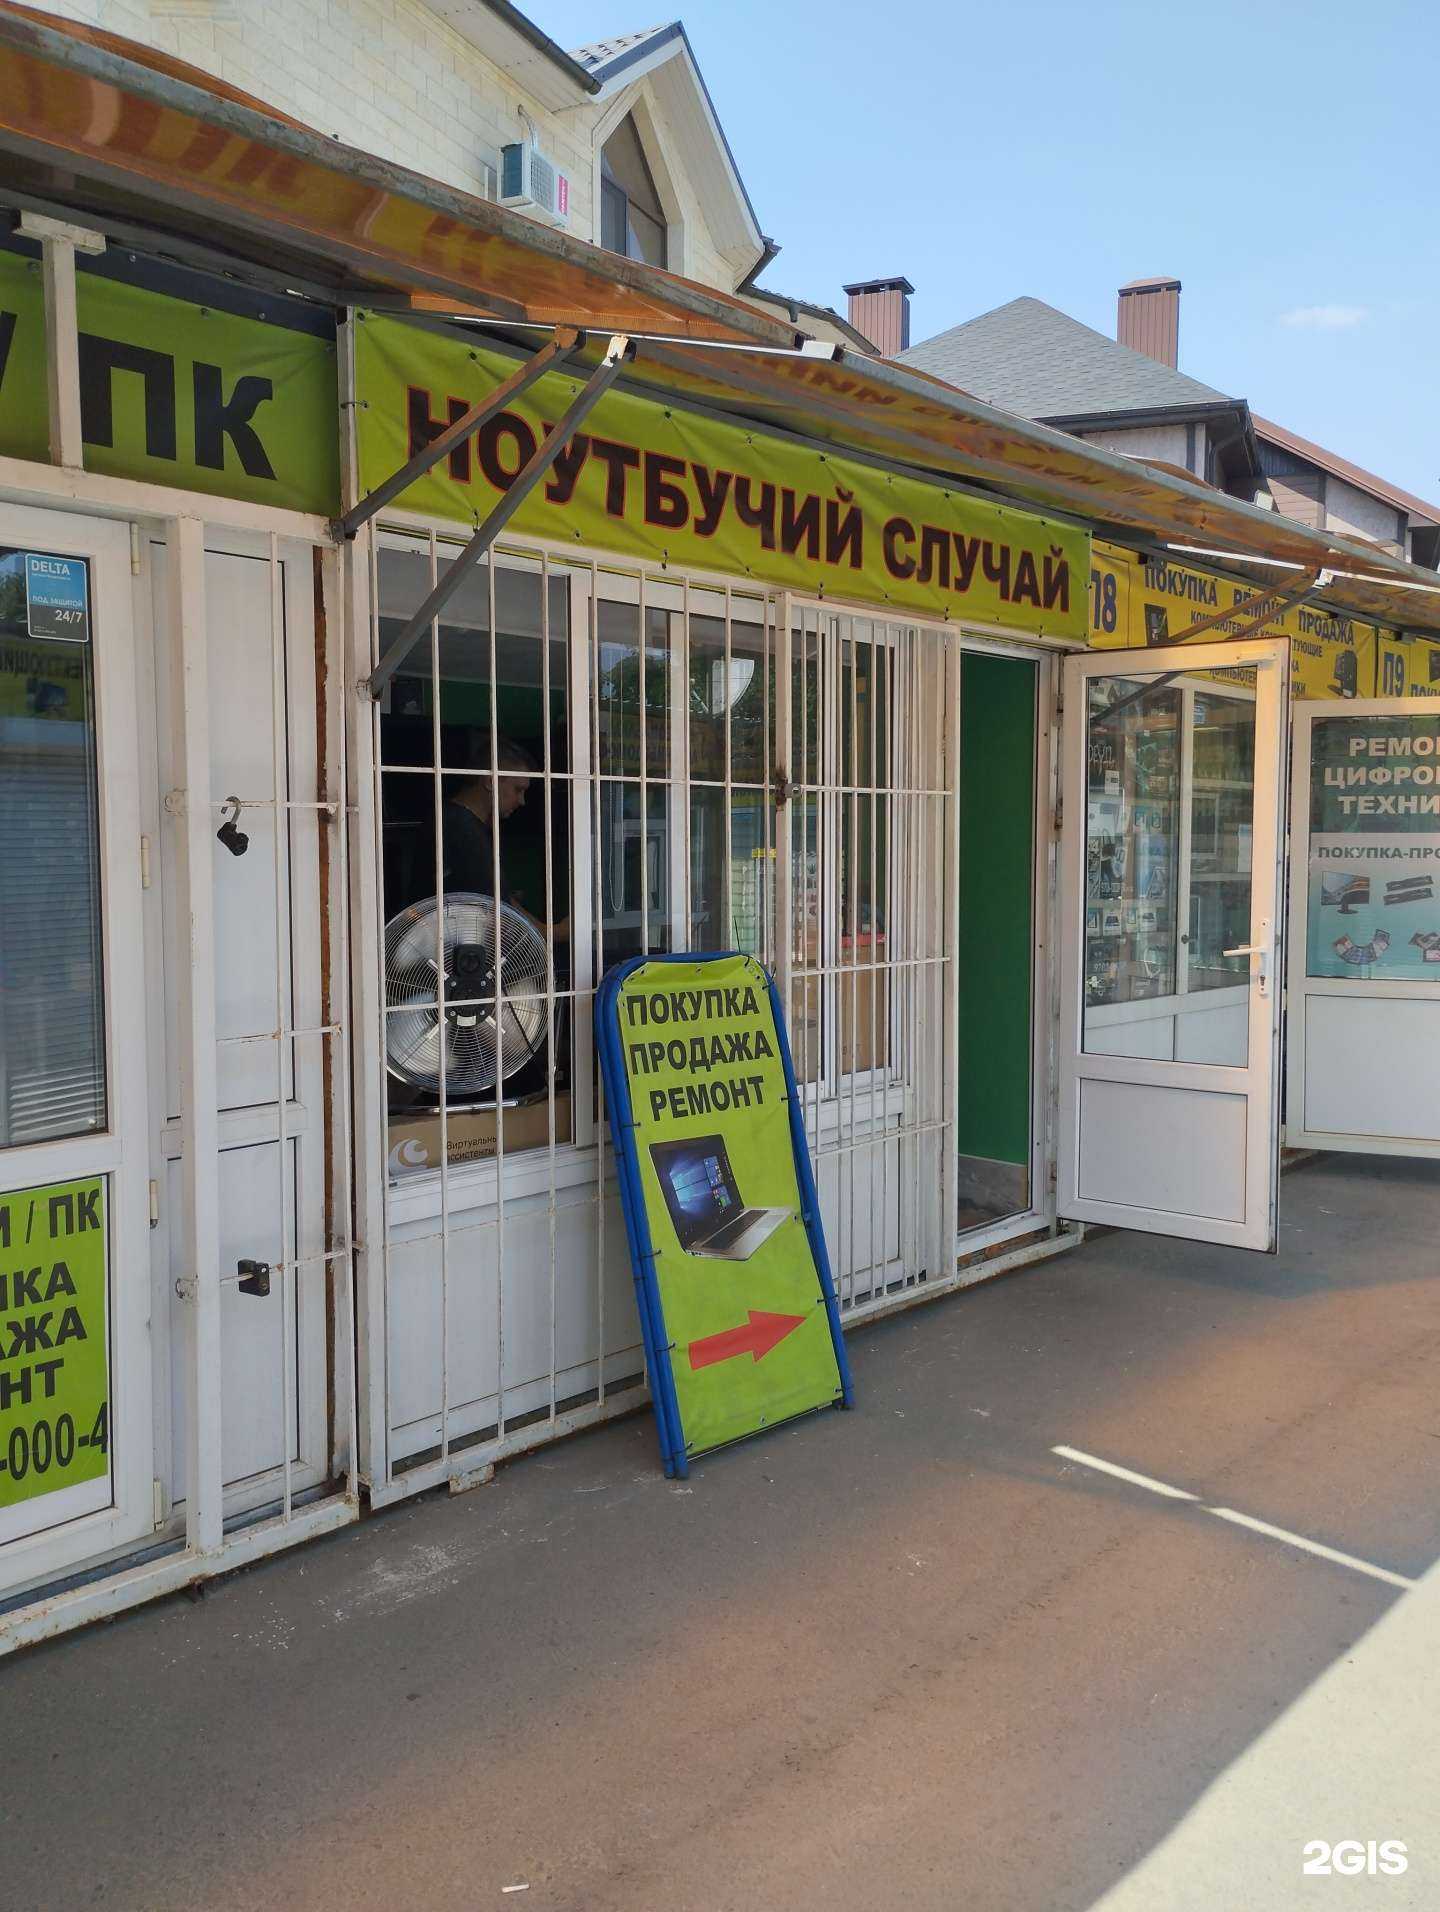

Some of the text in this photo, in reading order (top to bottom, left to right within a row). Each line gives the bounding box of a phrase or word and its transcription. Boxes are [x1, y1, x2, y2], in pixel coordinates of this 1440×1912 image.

[78, 332, 278, 481] ПК
[407, 384, 863, 569] НОУТБУЧИЙ
[882, 516, 1069, 613] СЛУЧАЙ
[31, 559, 70, 576] DELTA
[55, 609, 82, 624] 24/7
[1145, 559, 1218, 607] ПОКУПКА
[1298, 608, 1354, 645] ПРОДАЖА
[1383, 651, 1404, 697] П9
[1337, 795, 1440, 815] ТЕХНИ
[626, 986, 760, 1026] ПОКУПКА
[629, 1030, 775, 1075] ПРОДАЖА
[649, 1075, 765, 1121] РЕМОНТ
[447, 1147, 495, 1161] ссистенты
[49, 1188, 100, 1239] ПК
[0, 1306, 87, 1361] ЖА
[0, 1358, 64, 1410] НТ
